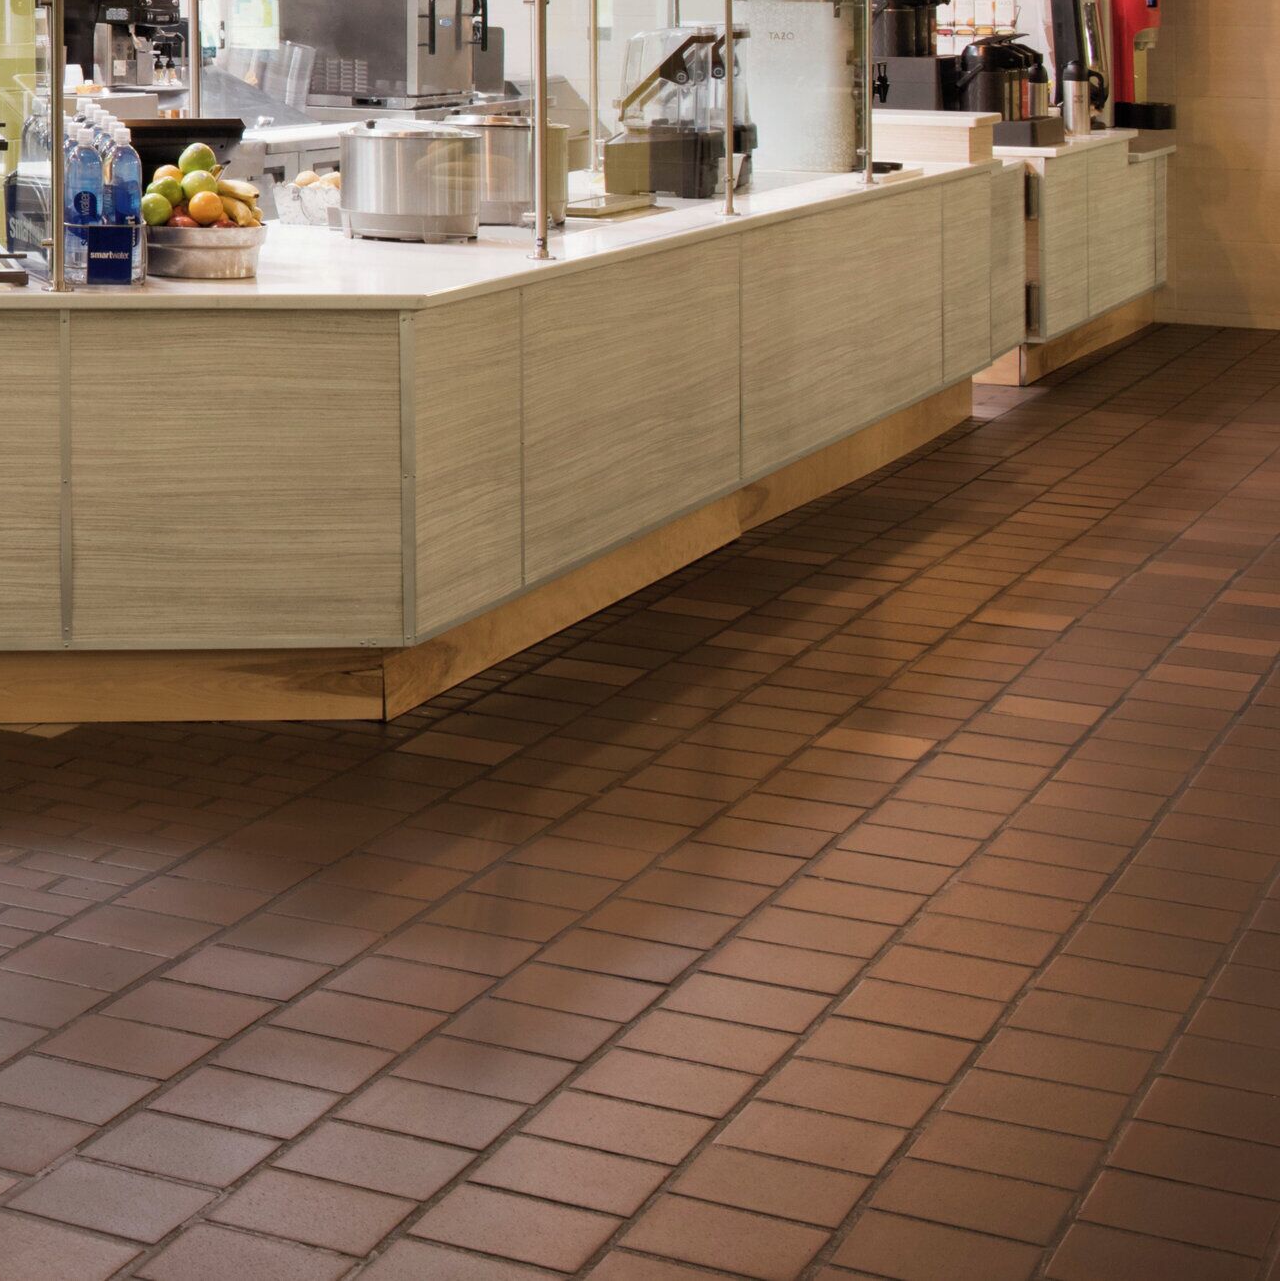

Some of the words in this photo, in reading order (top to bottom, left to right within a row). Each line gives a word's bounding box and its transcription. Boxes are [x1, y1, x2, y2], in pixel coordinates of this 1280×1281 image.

[768, 31, 794, 40] TAZO
[81, 193, 90, 216] water
[90, 251, 129, 259] smartwater
